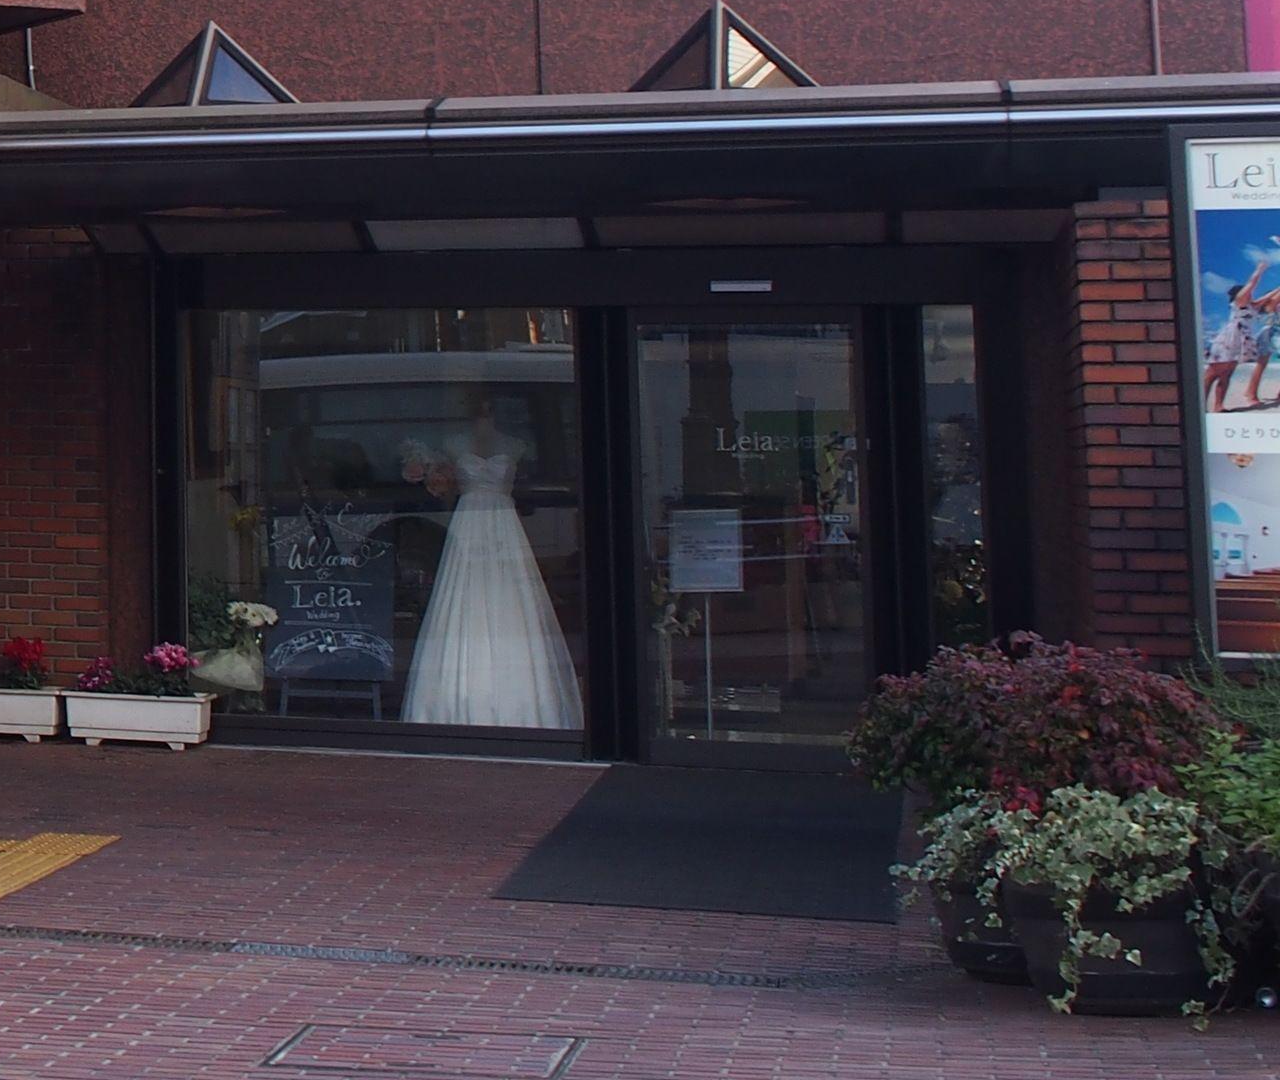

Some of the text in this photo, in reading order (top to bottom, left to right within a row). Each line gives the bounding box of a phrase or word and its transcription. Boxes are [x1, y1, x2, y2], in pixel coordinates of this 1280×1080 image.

[716, 427, 780, 452] Leia.
[288, 535, 386, 570] Welcome
[292, 584, 363, 609] Leia.
